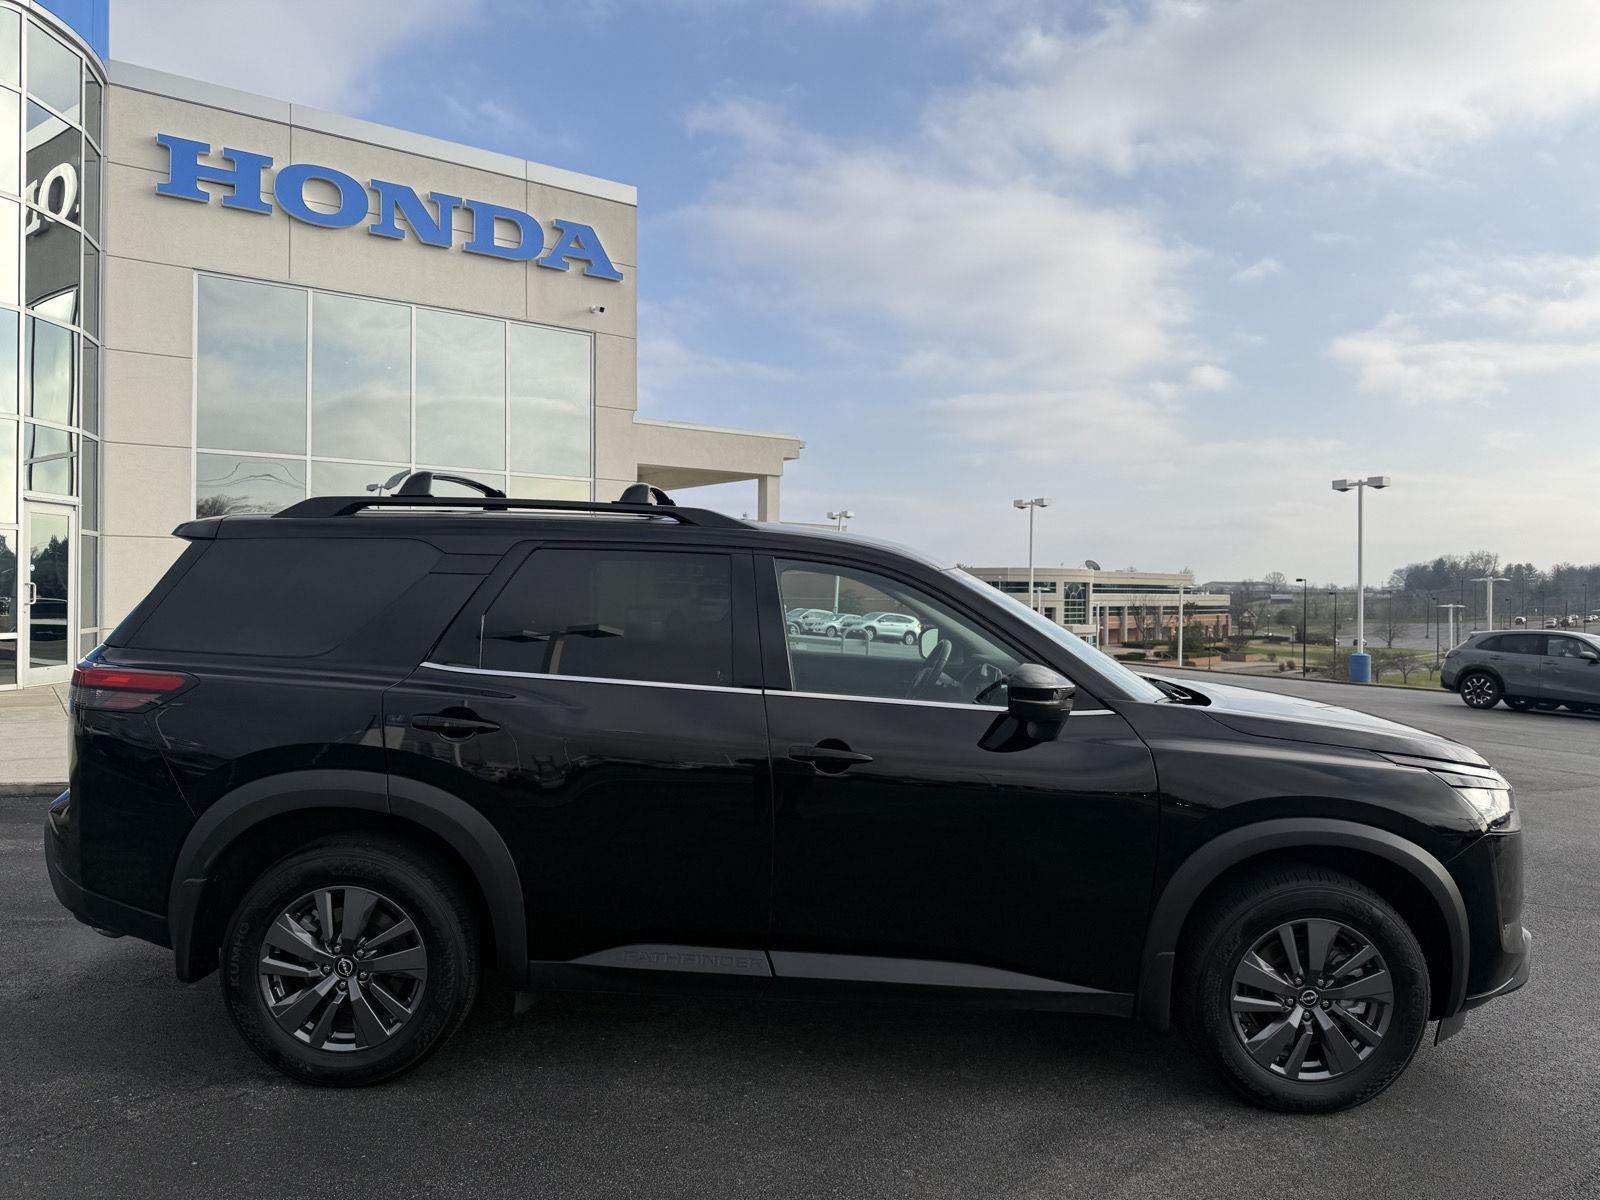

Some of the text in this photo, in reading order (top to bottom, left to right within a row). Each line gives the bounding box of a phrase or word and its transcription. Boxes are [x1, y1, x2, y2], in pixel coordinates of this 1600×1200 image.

[155, 133, 624, 282] HONDA
[231, 922, 249, 987] KUMHO
[623, 950, 765, 969] PATHFINDER
